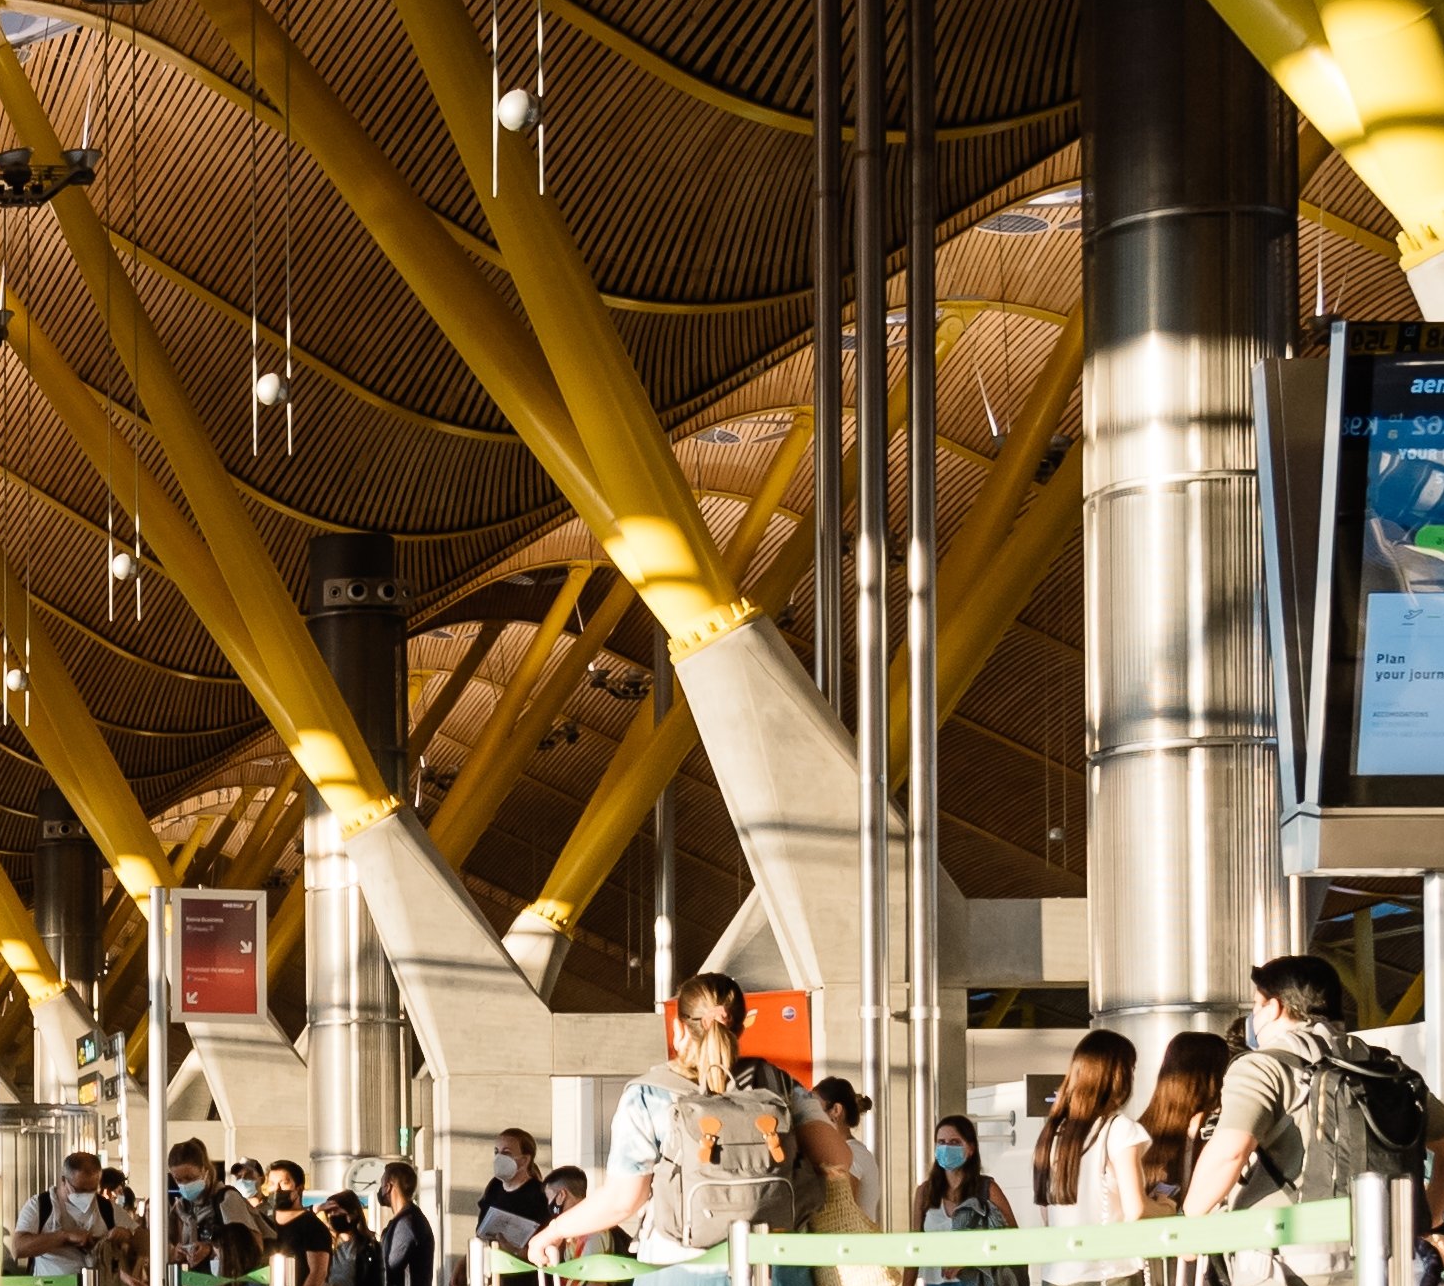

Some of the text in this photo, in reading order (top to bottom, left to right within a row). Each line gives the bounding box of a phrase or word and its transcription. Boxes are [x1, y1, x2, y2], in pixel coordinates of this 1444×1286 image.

[1399, 448, 1437, 460] YOUR
[1376, 653, 1406, 664] Plan
[1375, 671, 1406, 682] your
